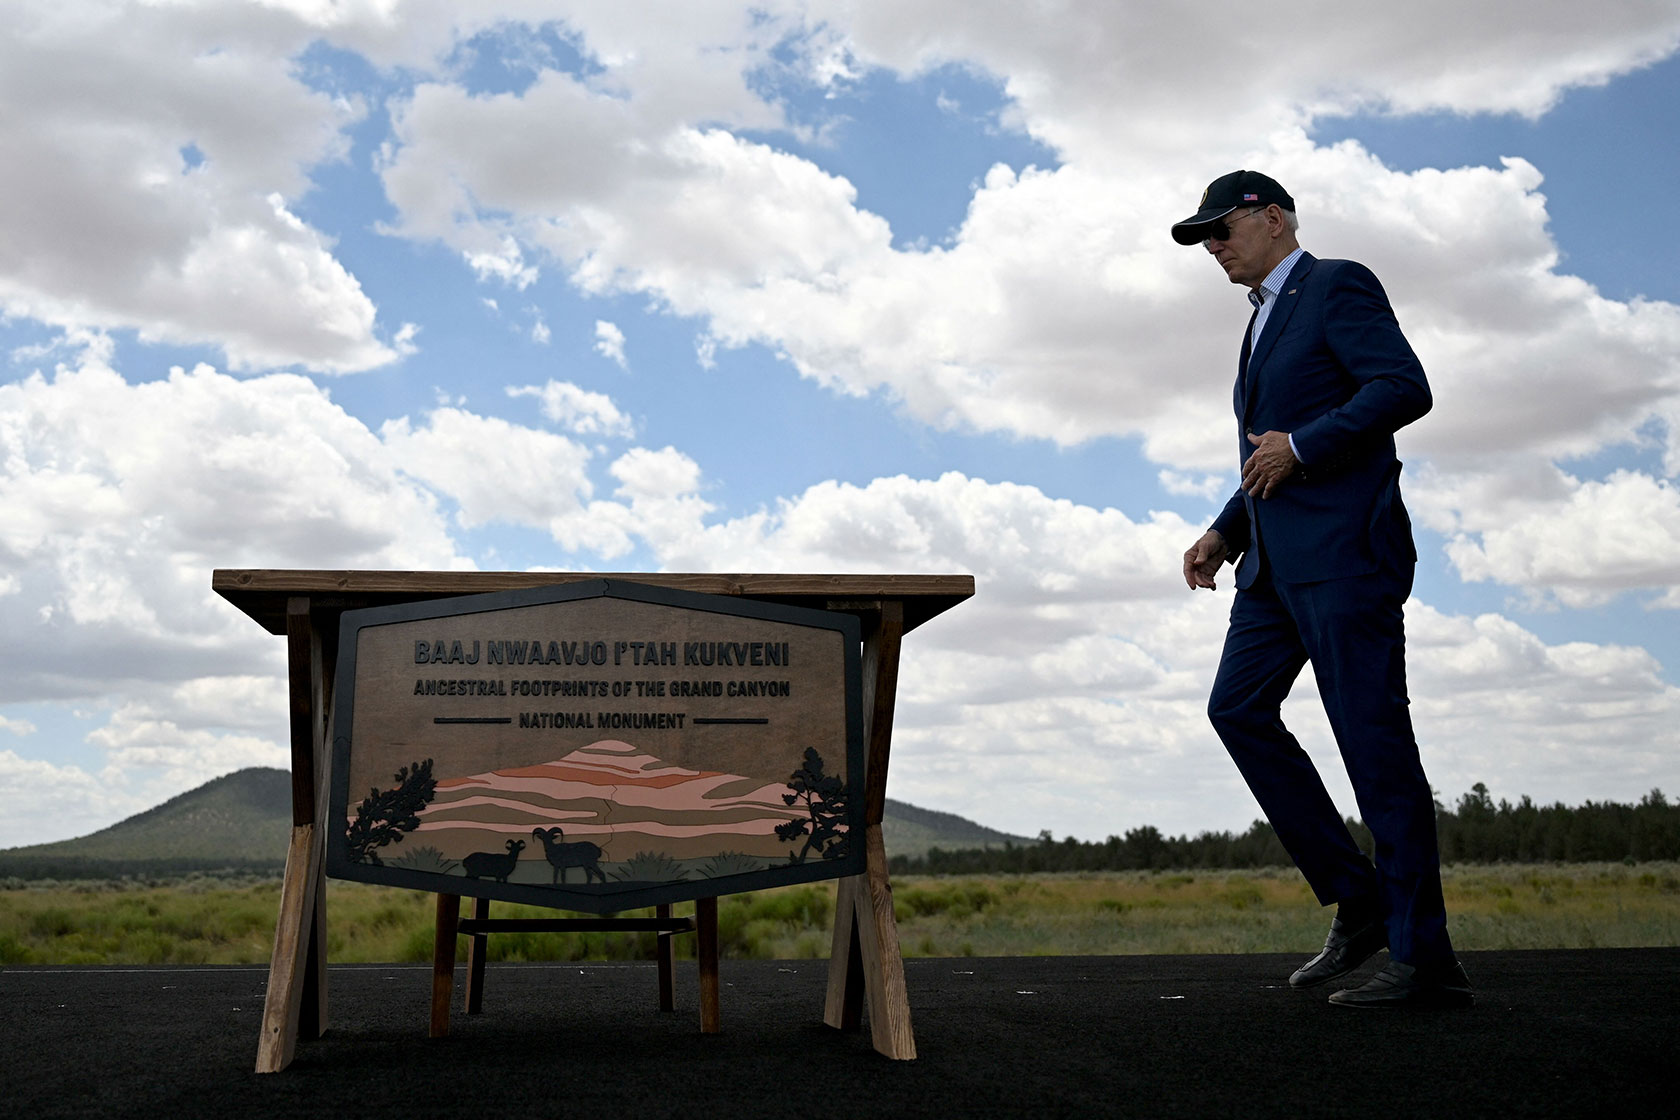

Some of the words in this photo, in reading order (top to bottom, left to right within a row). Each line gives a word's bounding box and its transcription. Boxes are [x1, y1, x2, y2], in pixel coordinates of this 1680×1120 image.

[414, 640, 480, 664] BAAJ
[487, 640, 607, 665] NWAAVJO
[683, 641, 789, 667] KUKVENI
[413, 680, 507, 696] ANCESTRAL
[511, 680, 608, 697] FOOTPRINTS
[612, 681, 632, 697] OF
[635, 681, 665, 697] THE
[669, 681, 723, 697] GRAND
[727, 681, 790, 697] CANYON
[519, 712, 594, 729] NATIONAL
[598, 712, 685, 729] MONUMENT
